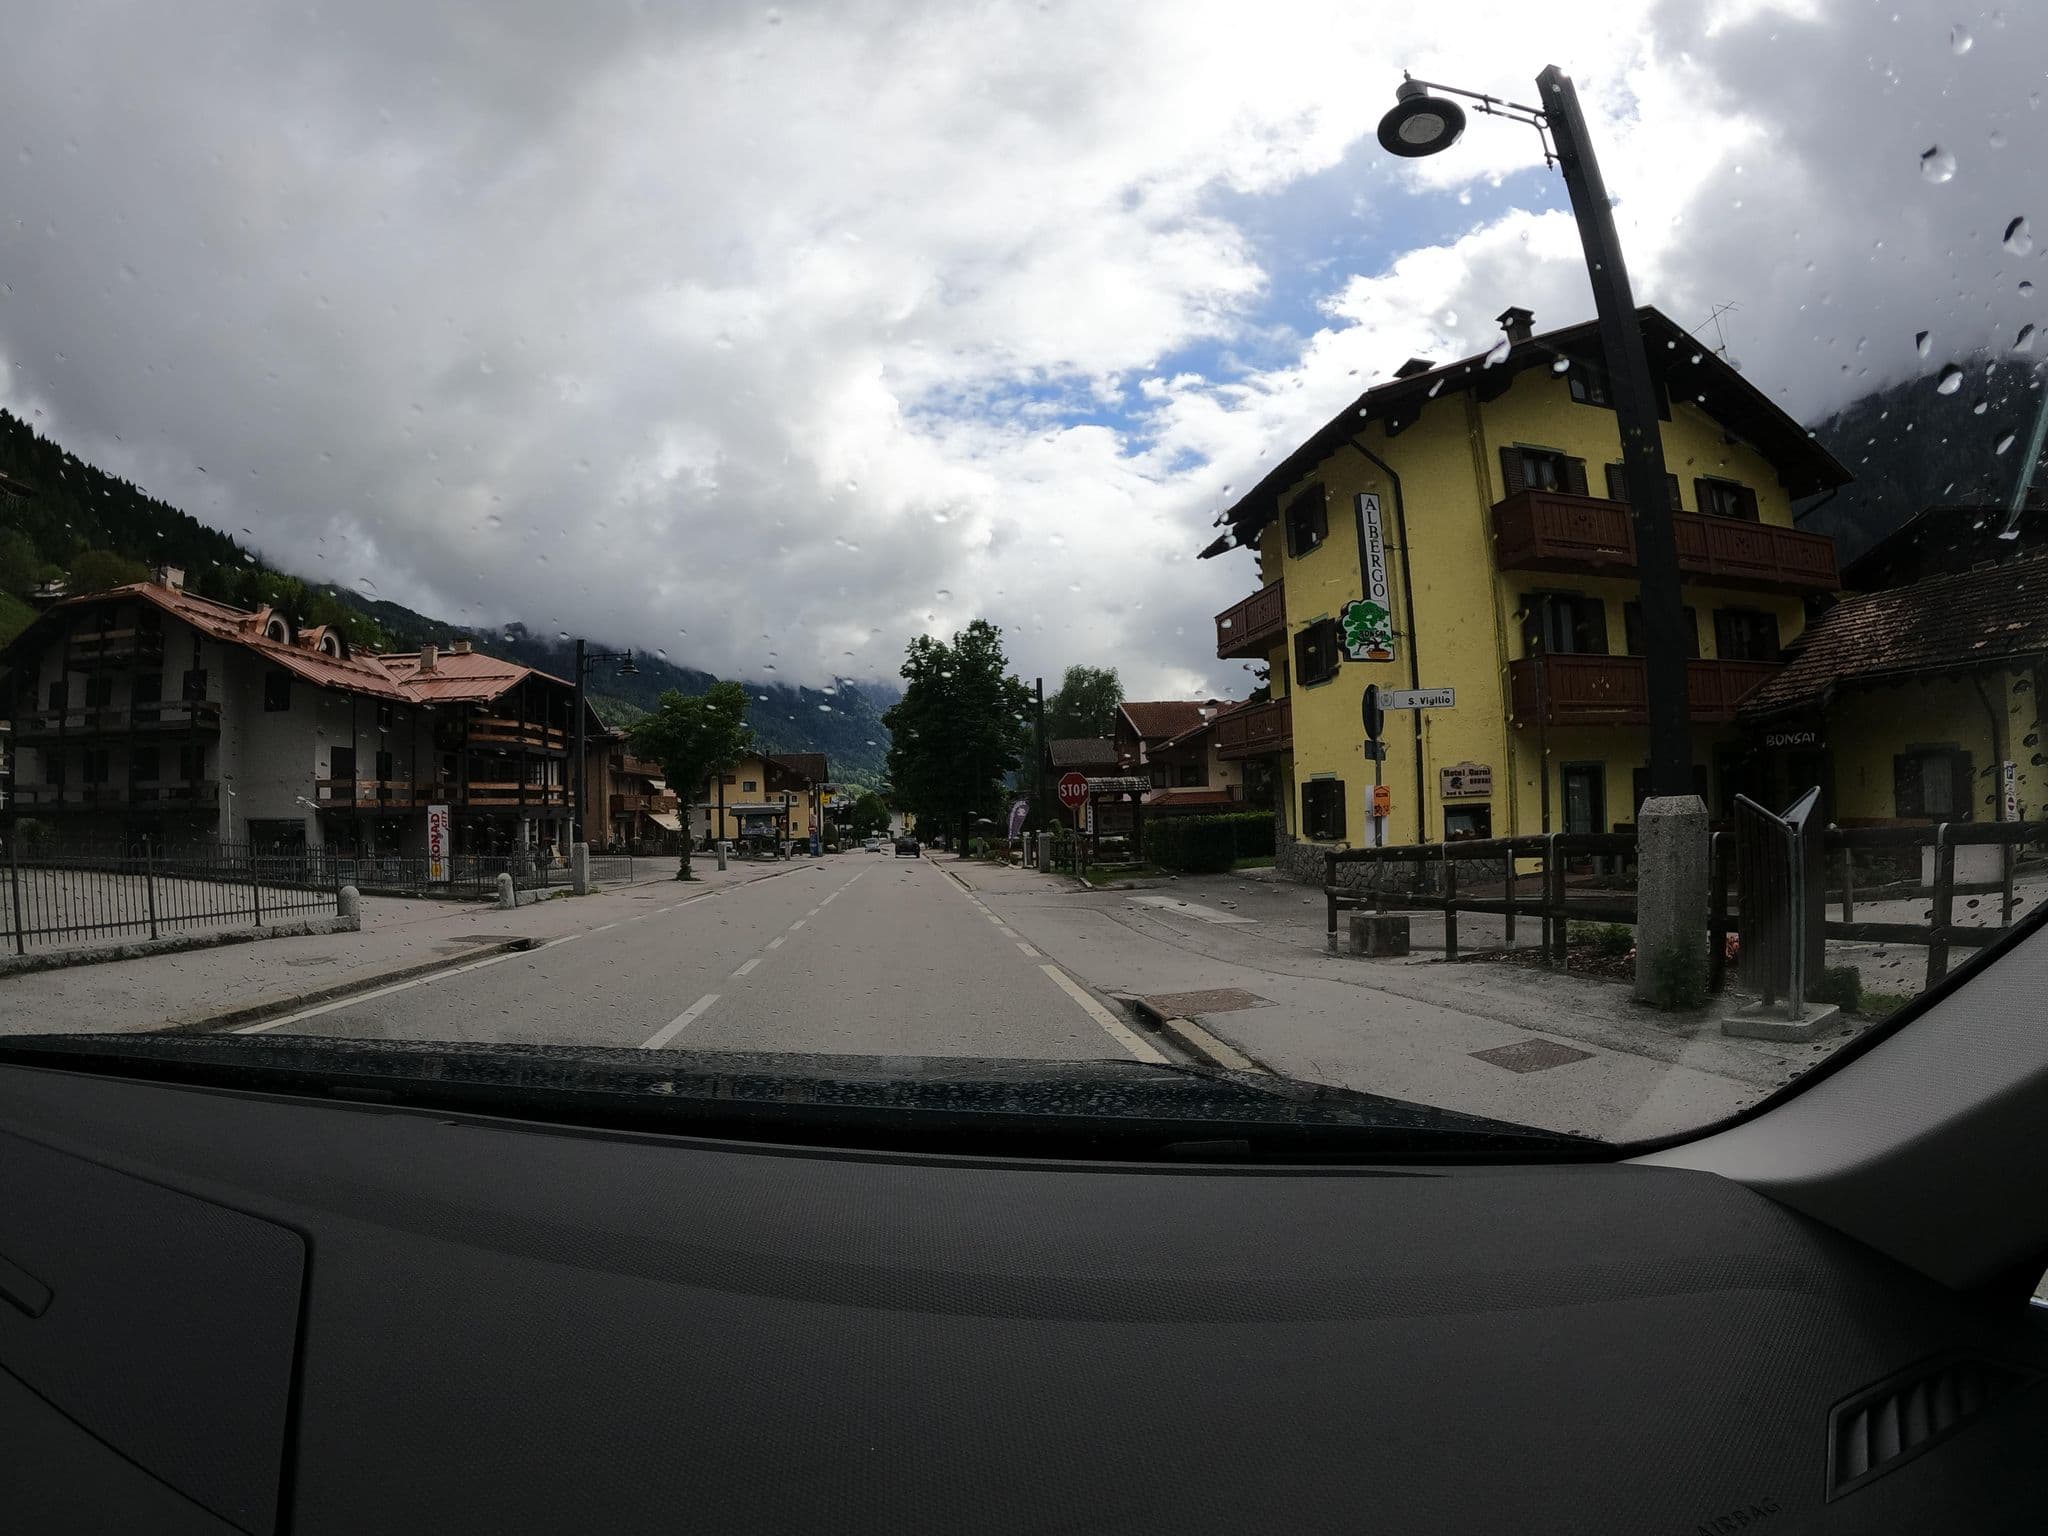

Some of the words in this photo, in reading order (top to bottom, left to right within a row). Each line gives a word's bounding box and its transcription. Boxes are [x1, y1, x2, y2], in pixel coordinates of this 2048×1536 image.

[1364, 497, 1386, 598] ALBERGO
[1408, 697, 1417, 706] S.
[1419, 695, 1451, 706] Vigilio
[1766, 732, 1816, 746] BONSAI
[1060, 784, 1088, 797] STOP
[431, 813, 440, 862] CONAD
